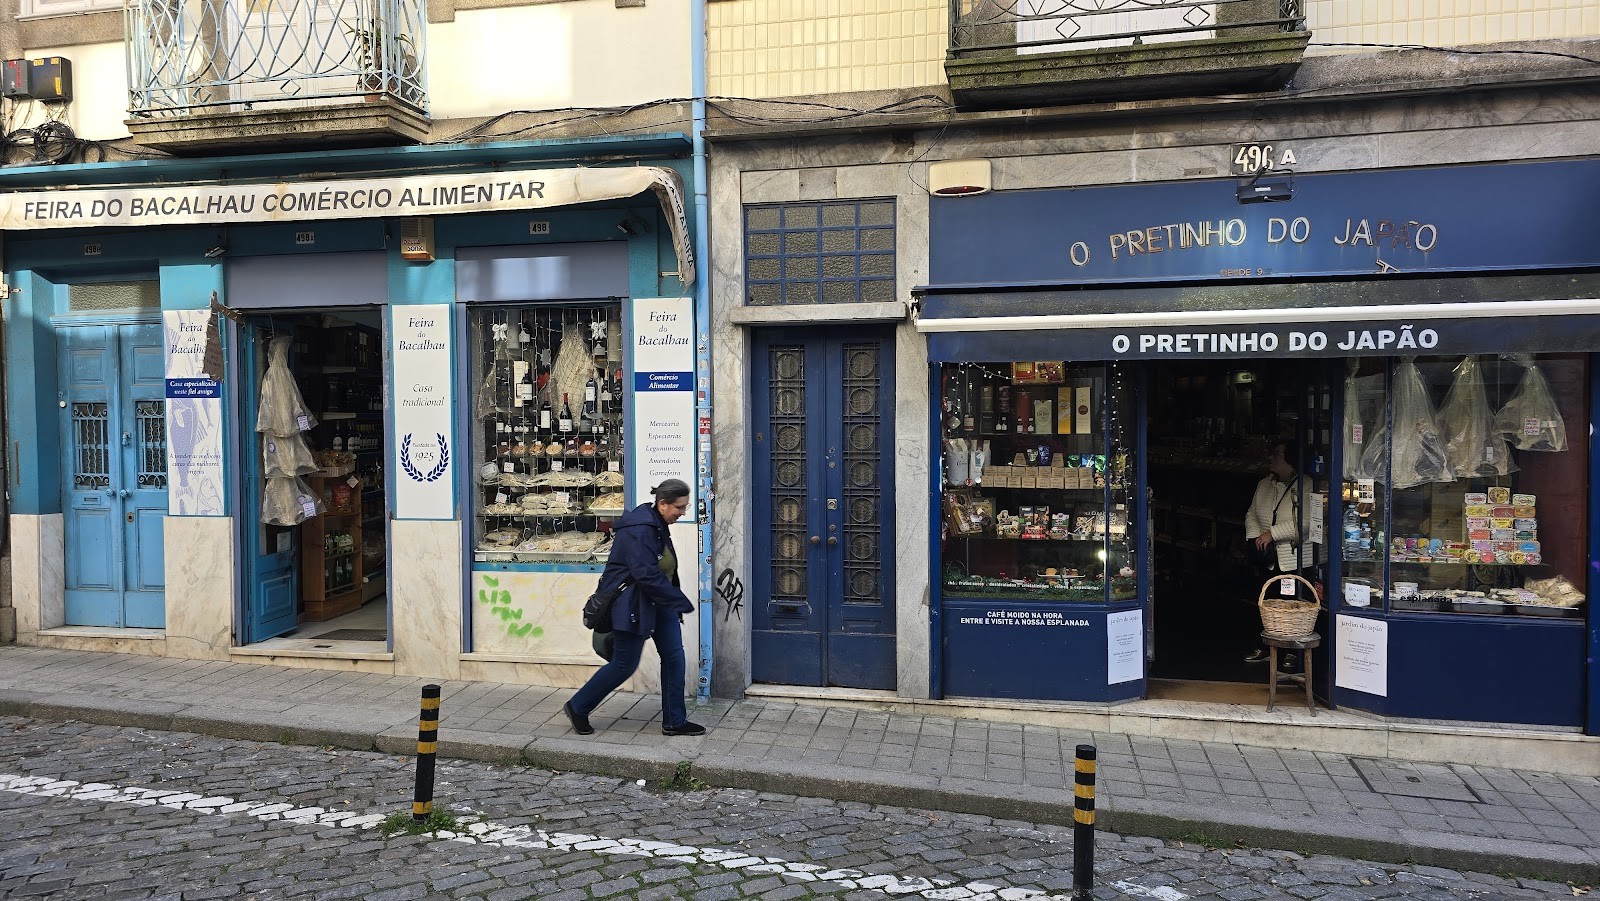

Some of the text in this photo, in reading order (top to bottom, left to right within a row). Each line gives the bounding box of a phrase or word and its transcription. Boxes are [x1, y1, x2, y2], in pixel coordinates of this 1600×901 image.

[1235, 145, 1297, 172] 496 A
[25, 181, 545, 220] FEIRA DO BACALHAU COMÉRCIO ALIMENTAR
[532, 222, 547, 233] 498
[1070, 217, 1438, 267] O PRETINHO DO JAPÃO
[649, 311, 677, 322] Feira
[180, 322, 203, 332] Feira
[409, 317, 434, 328] Feira
[638, 334, 689, 346] Bacalhau
[1112, 324, 1439, 353] O PRETINHO DO JAPÃO
[171, 343, 206, 354] Bacalh
[399, 340, 445, 350] Bacalhau
[649, 373, 679, 381] Comércio
[183, 380, 217, 388] especializada
[413, 383, 433, 392] Casa
[402, 397, 445, 406] tradicional
[414, 451, 434, 461] 1925
[649, 469, 681, 477] Garrafeira
[1400, 594, 1452, 603] esplanada
[987, 610, 1005, 618] CAFÉ
[960, 617, 984, 625] ENTRE
[1047, 619, 1090, 627] ESPLANADA
